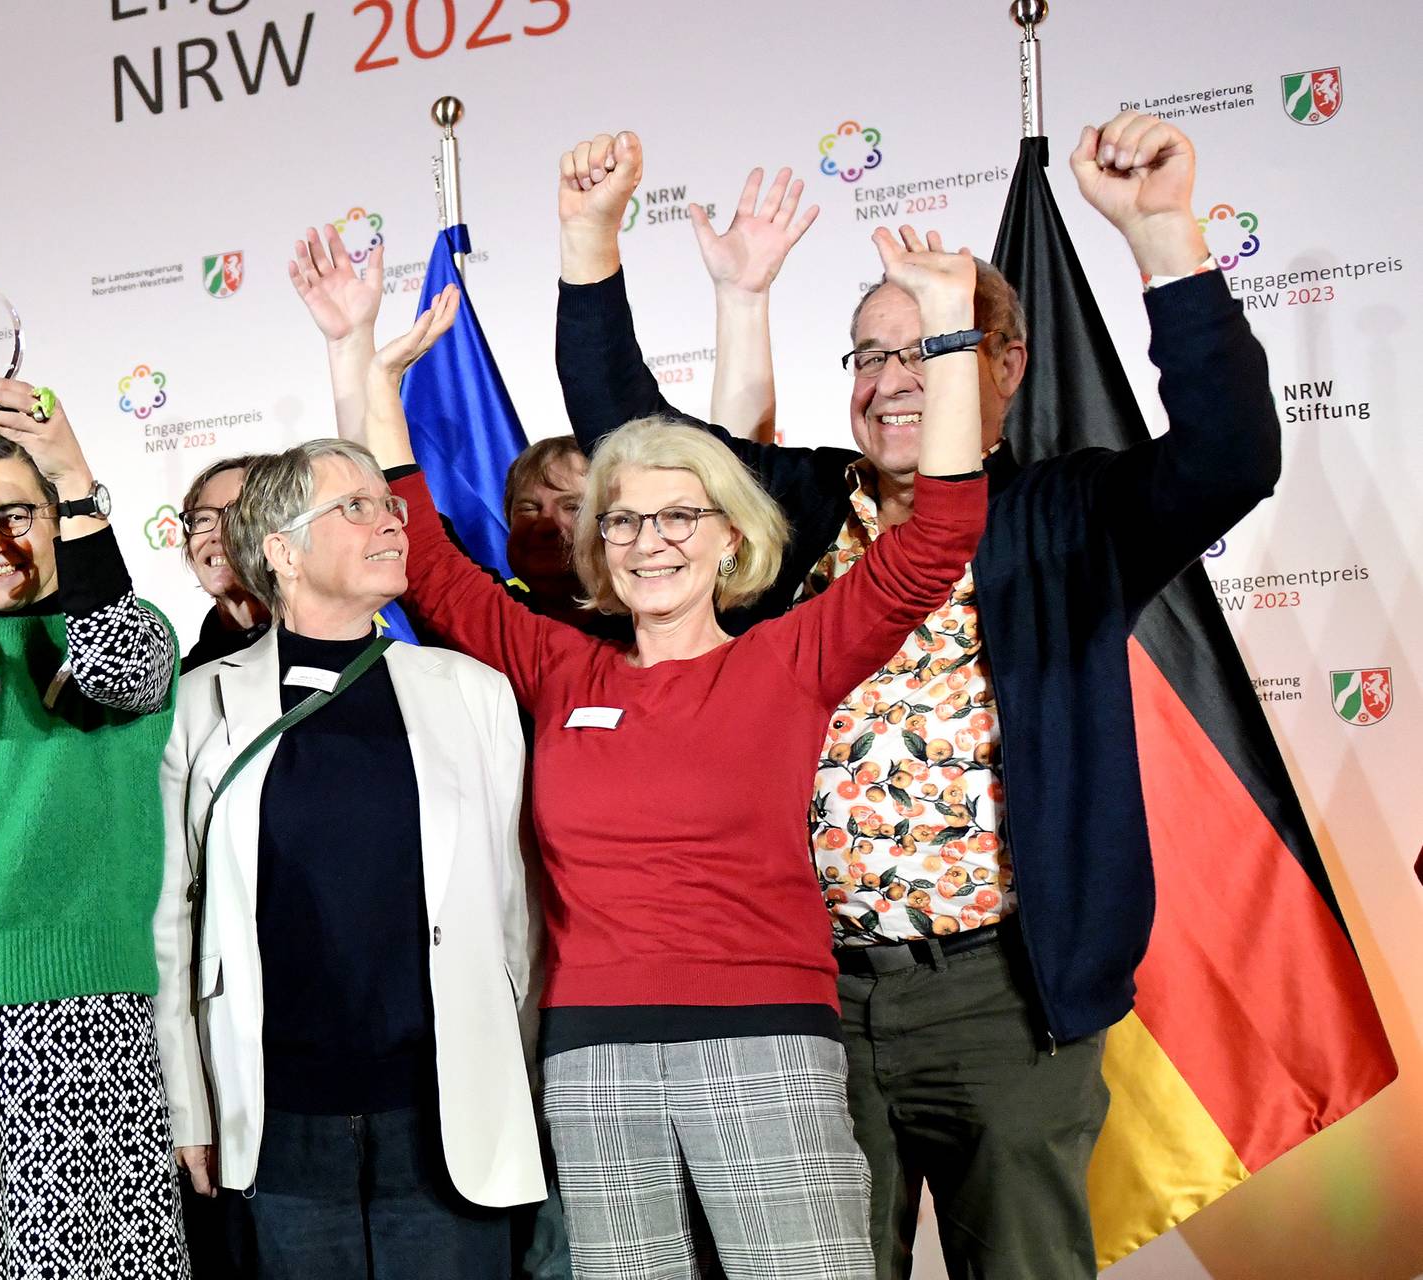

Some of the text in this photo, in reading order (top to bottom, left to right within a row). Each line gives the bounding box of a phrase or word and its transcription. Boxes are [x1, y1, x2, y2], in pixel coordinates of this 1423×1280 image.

[112, 13, 315, 123] NRW
[1120, 83, 1254, 113] Die Landesregierung
[646, 185, 687, 206] NRW
[854, 166, 1009, 203] Engagementpreis
[856, 194, 949, 221] NRW 2023
[91, 264, 184, 286] Die Landesregierung
[1229, 256, 1404, 292] Engagementpreis
[91, 275, 185, 297] Nordrhein-Westfalen
[1245, 286, 1335, 311] RW 2023
[657, 367, 695, 385] 2023
[1284, 380, 1334, 402] NRW
[144, 409, 263, 437] Engagementpreis
[1285, 402, 1371, 424] Stiftung
[145, 432, 217, 454] NRW 2023
[1210, 564, 1370, 594] ngagementpreis
[1253, 591, 1301, 609] 2023
